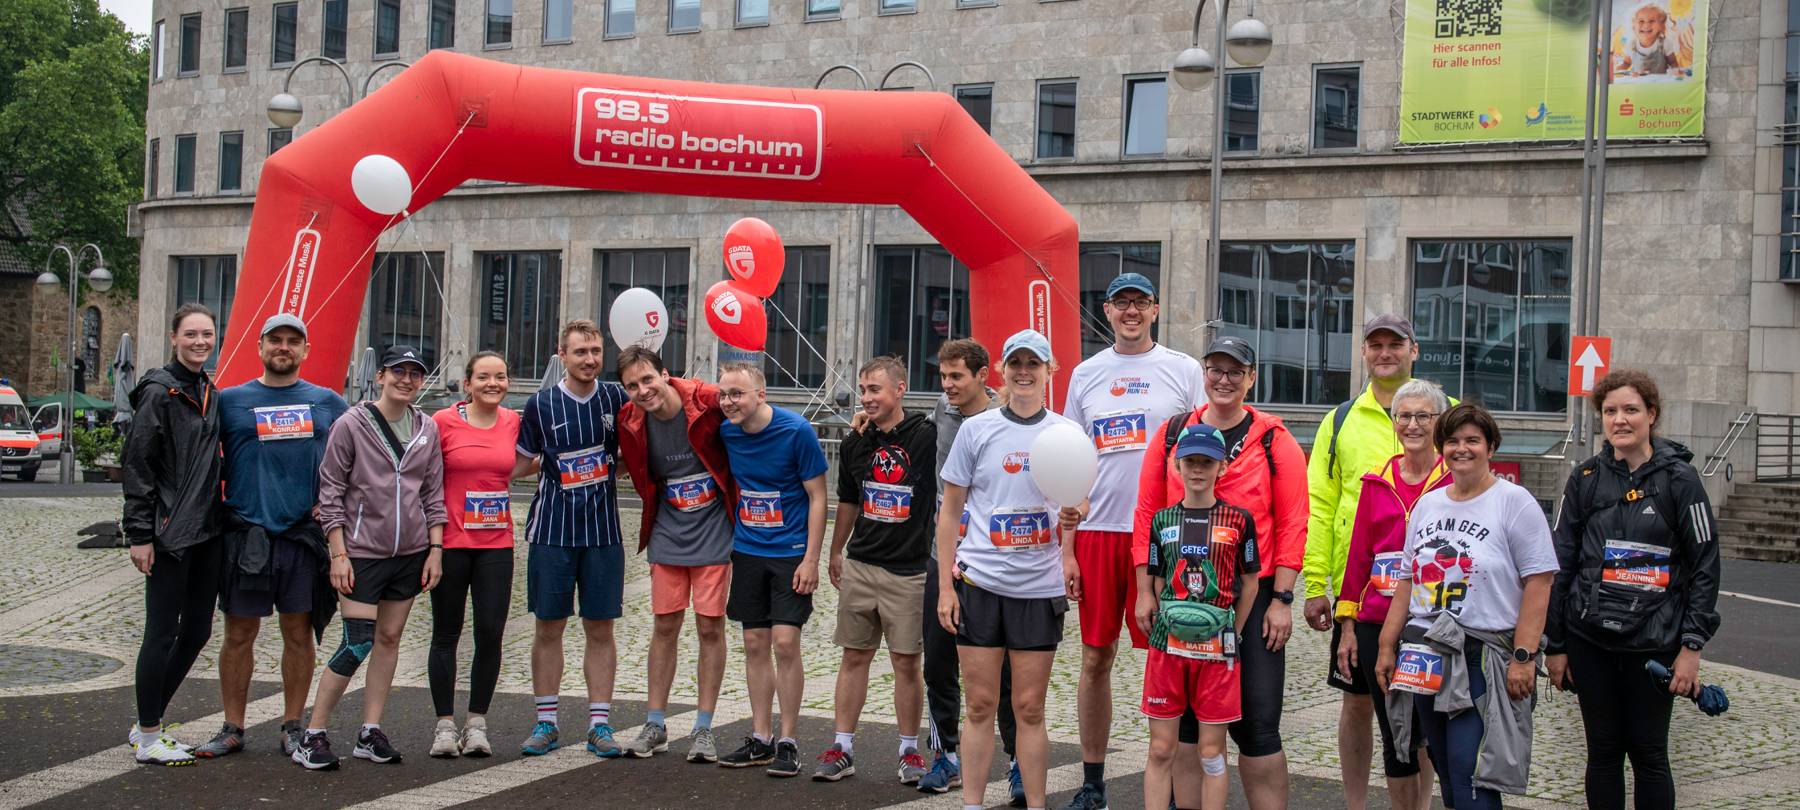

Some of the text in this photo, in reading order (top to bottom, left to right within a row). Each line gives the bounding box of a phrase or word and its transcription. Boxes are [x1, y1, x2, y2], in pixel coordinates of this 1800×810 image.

[1433, 42, 1502, 53] Hier scannen
[1432, 56, 1502, 68] für alle Infos!
[594, 98, 670, 124] 98.5
[1411, 111, 1475, 121] STADTWERKE
[1639, 106, 1693, 117] Sparkasse
[1433, 122, 1475, 131] BOCHUM
[1638, 119, 1682, 129] Bochum
[595, 128, 803, 157] radio bochum
[298, 240, 312, 268] Musik.
[1036, 289, 1045, 317] Musik.
[1108, 427, 1127, 436] 2475
[872, 507, 896, 517] LORENZ
[1011, 527, 1033, 535] 2474
[1416, 518, 1490, 541] TEAM GER
[1181, 545, 1208, 555] GETEC
[1616, 572, 1656, 583] JEANNINE
[1430, 581, 1468, 616] 12
[1185, 642, 1214, 651] MATTIS
[1400, 662, 1418, 674] 1021
